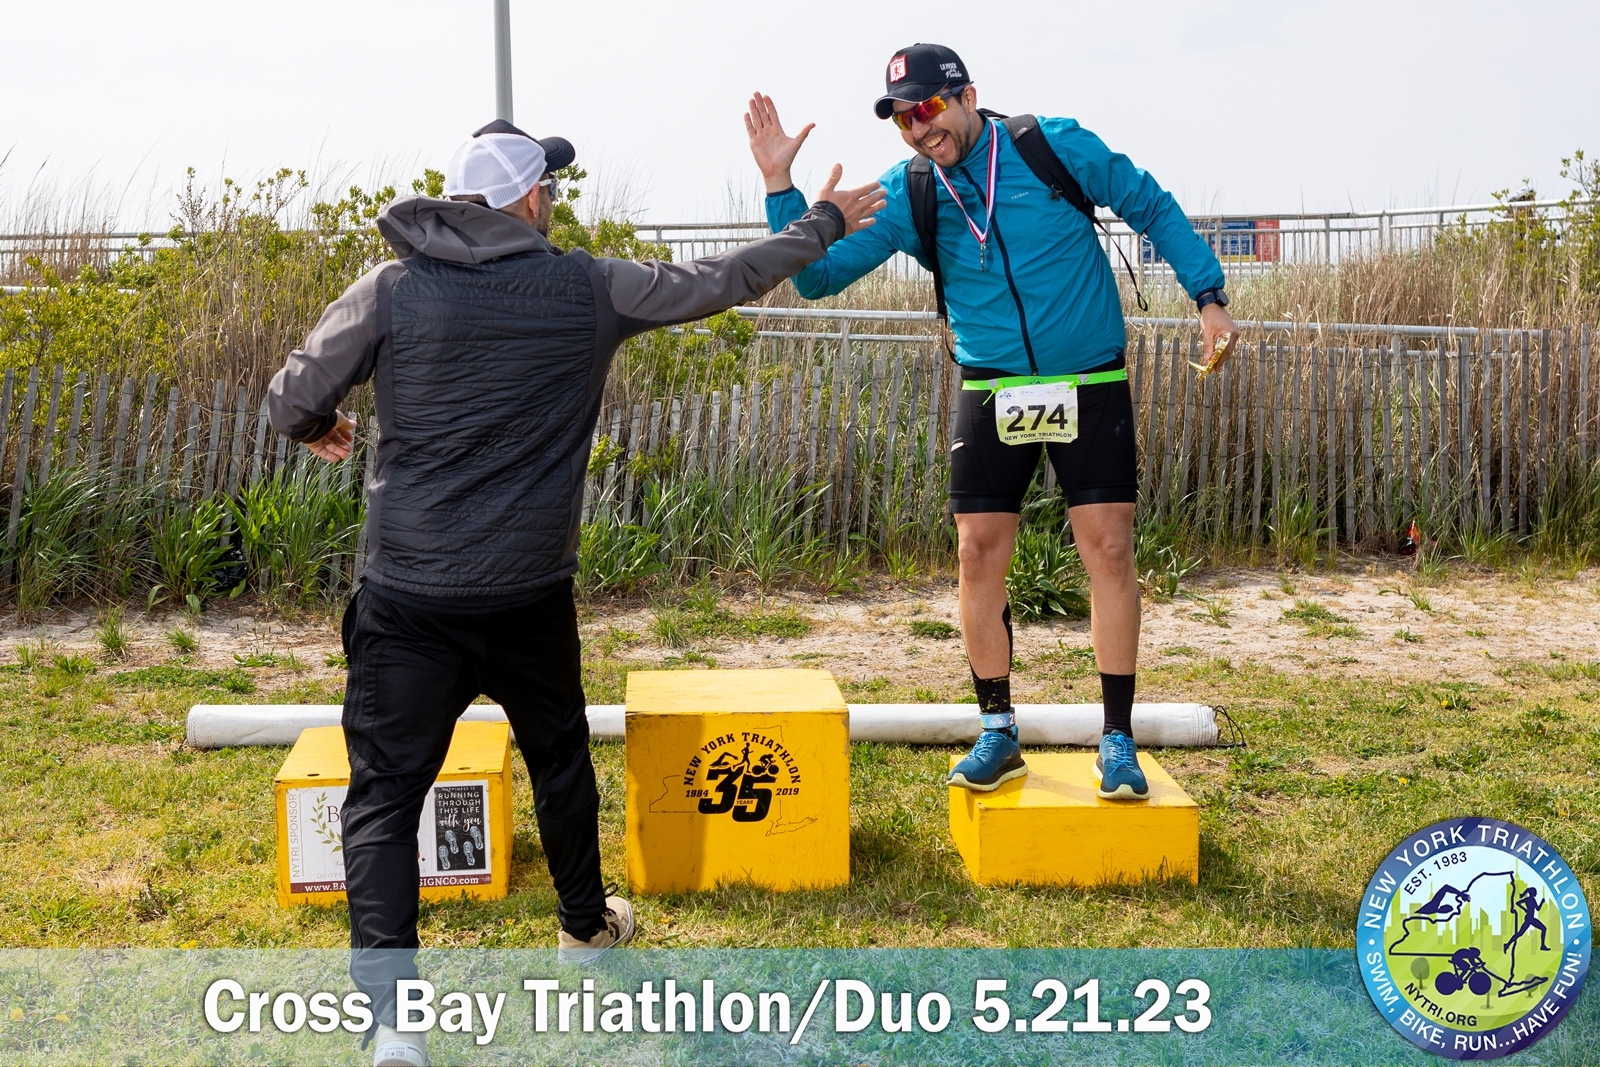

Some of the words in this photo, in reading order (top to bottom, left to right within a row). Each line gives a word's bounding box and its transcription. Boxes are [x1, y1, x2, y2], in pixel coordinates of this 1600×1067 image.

[1006, 404, 1068, 432] 274
[684, 755, 702, 786] NEW
[701, 733, 735, 754] YORK
[741, 732, 801, 783] TRIATHLON
[685, 789, 709, 797] 1984
[698, 766, 777, 822] 35
[776, 788, 799, 796] 2019
[289, 793, 298, 843] SPONSOR
[439, 814, 460, 827] with
[463, 817, 481, 832] you
[291, 848, 300, 877] NYTRI
